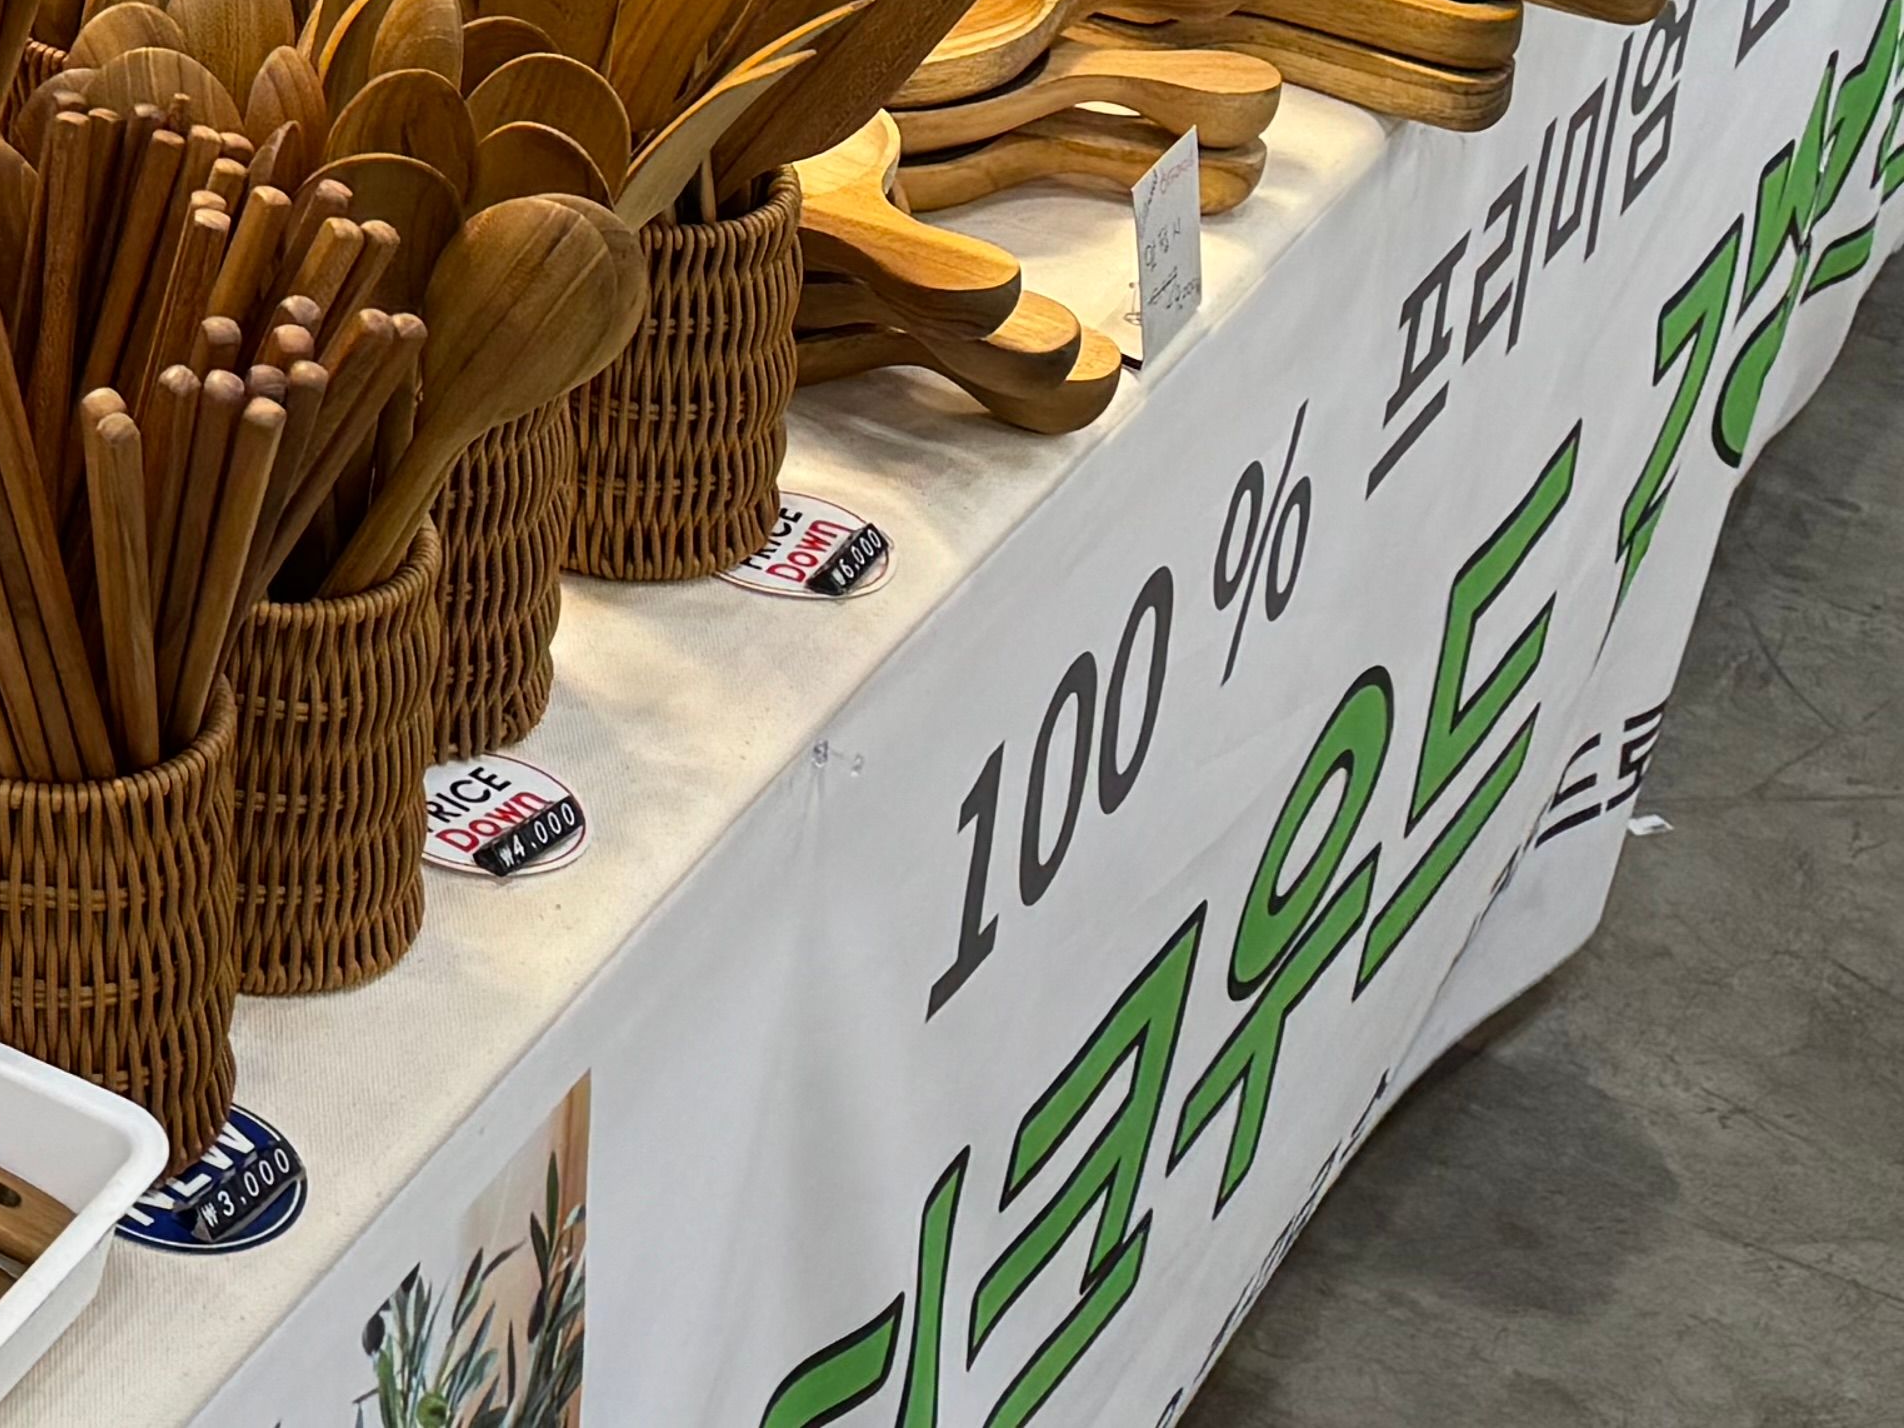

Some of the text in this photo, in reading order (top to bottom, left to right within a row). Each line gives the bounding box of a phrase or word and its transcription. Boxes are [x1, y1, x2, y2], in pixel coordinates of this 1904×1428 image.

[427, 766, 512, 833] RICE
[924, 564, 1176, 1021] 100
[1216, 401, 1311, 687] %
